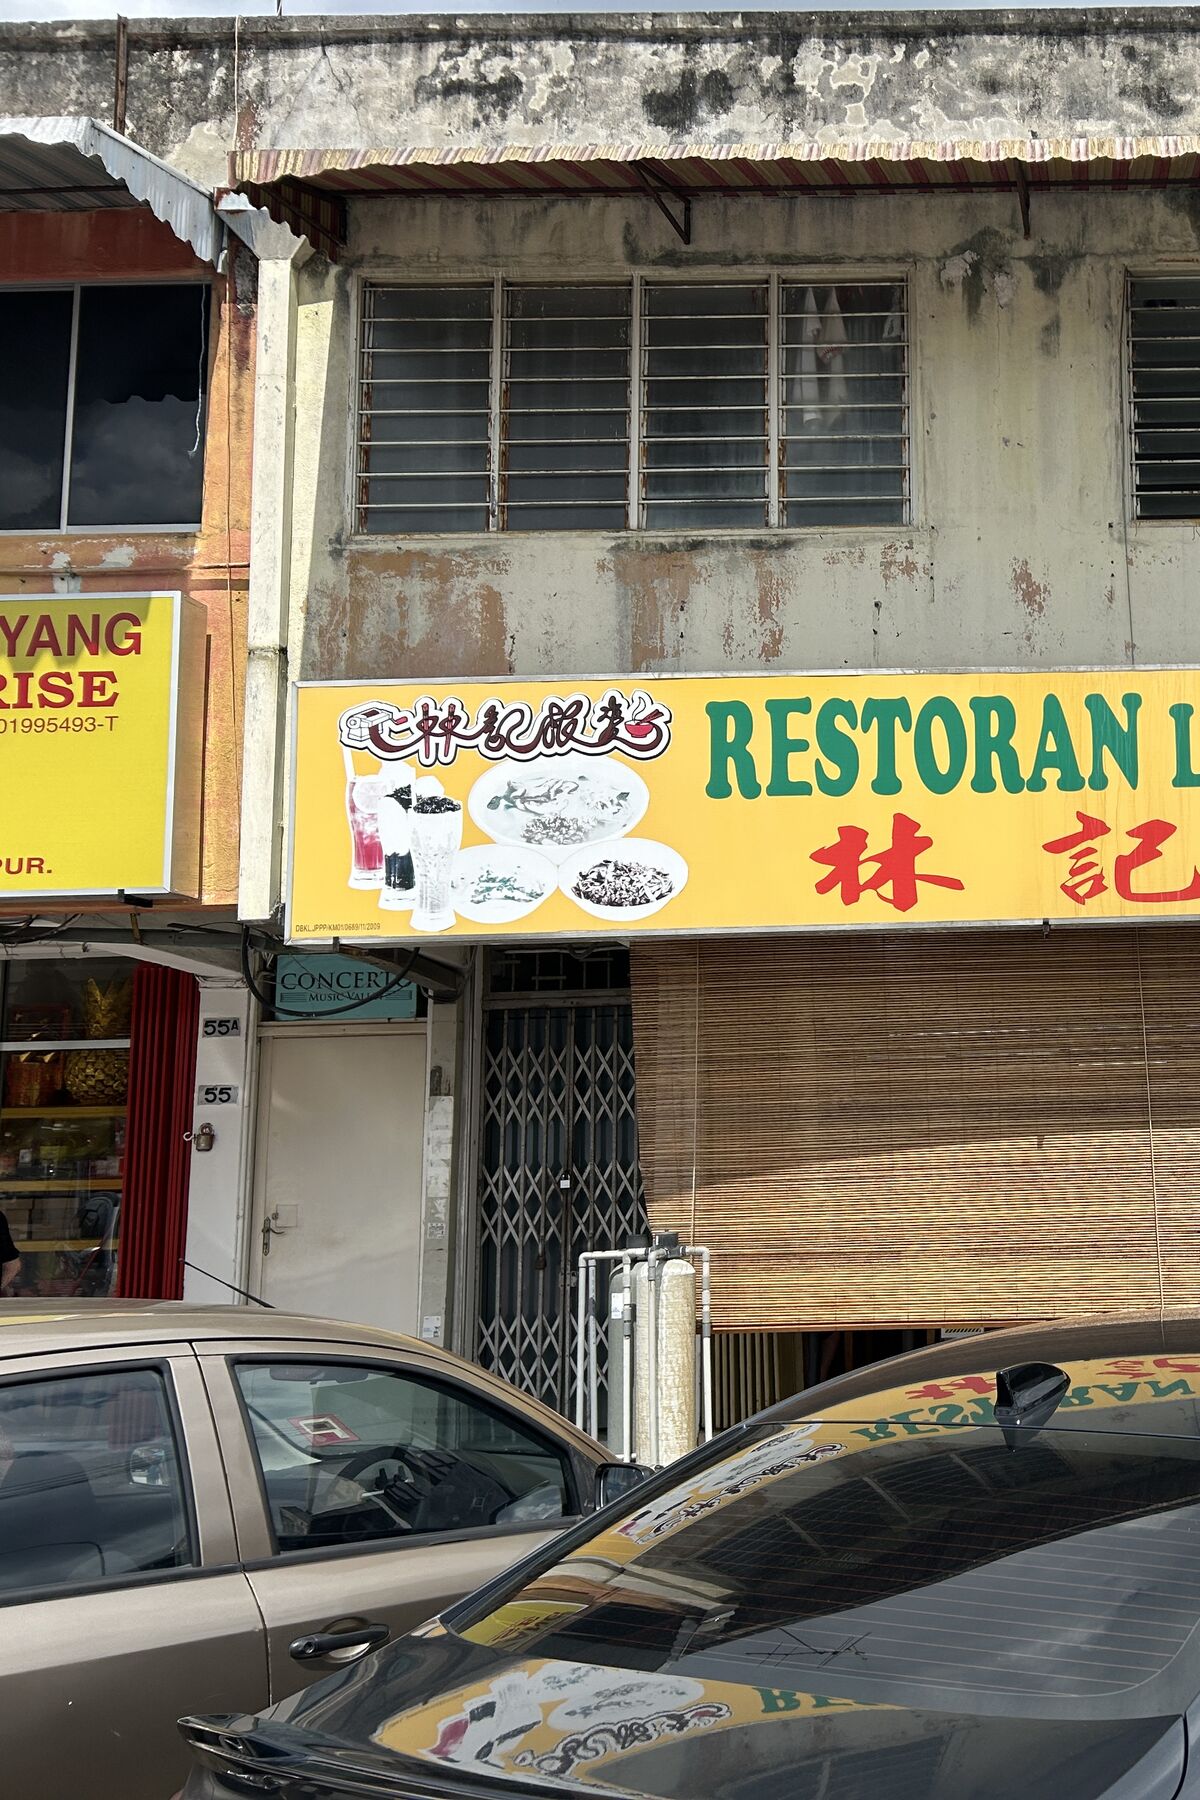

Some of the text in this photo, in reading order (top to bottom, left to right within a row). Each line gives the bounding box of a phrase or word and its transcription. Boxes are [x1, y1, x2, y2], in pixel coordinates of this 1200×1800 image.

[705, 694, 1143, 801] RESTORAN
[0, 857, 53, 875] UR.
[204, 1019, 239, 1036] 55A
[204, 1087, 232, 1104] 55
